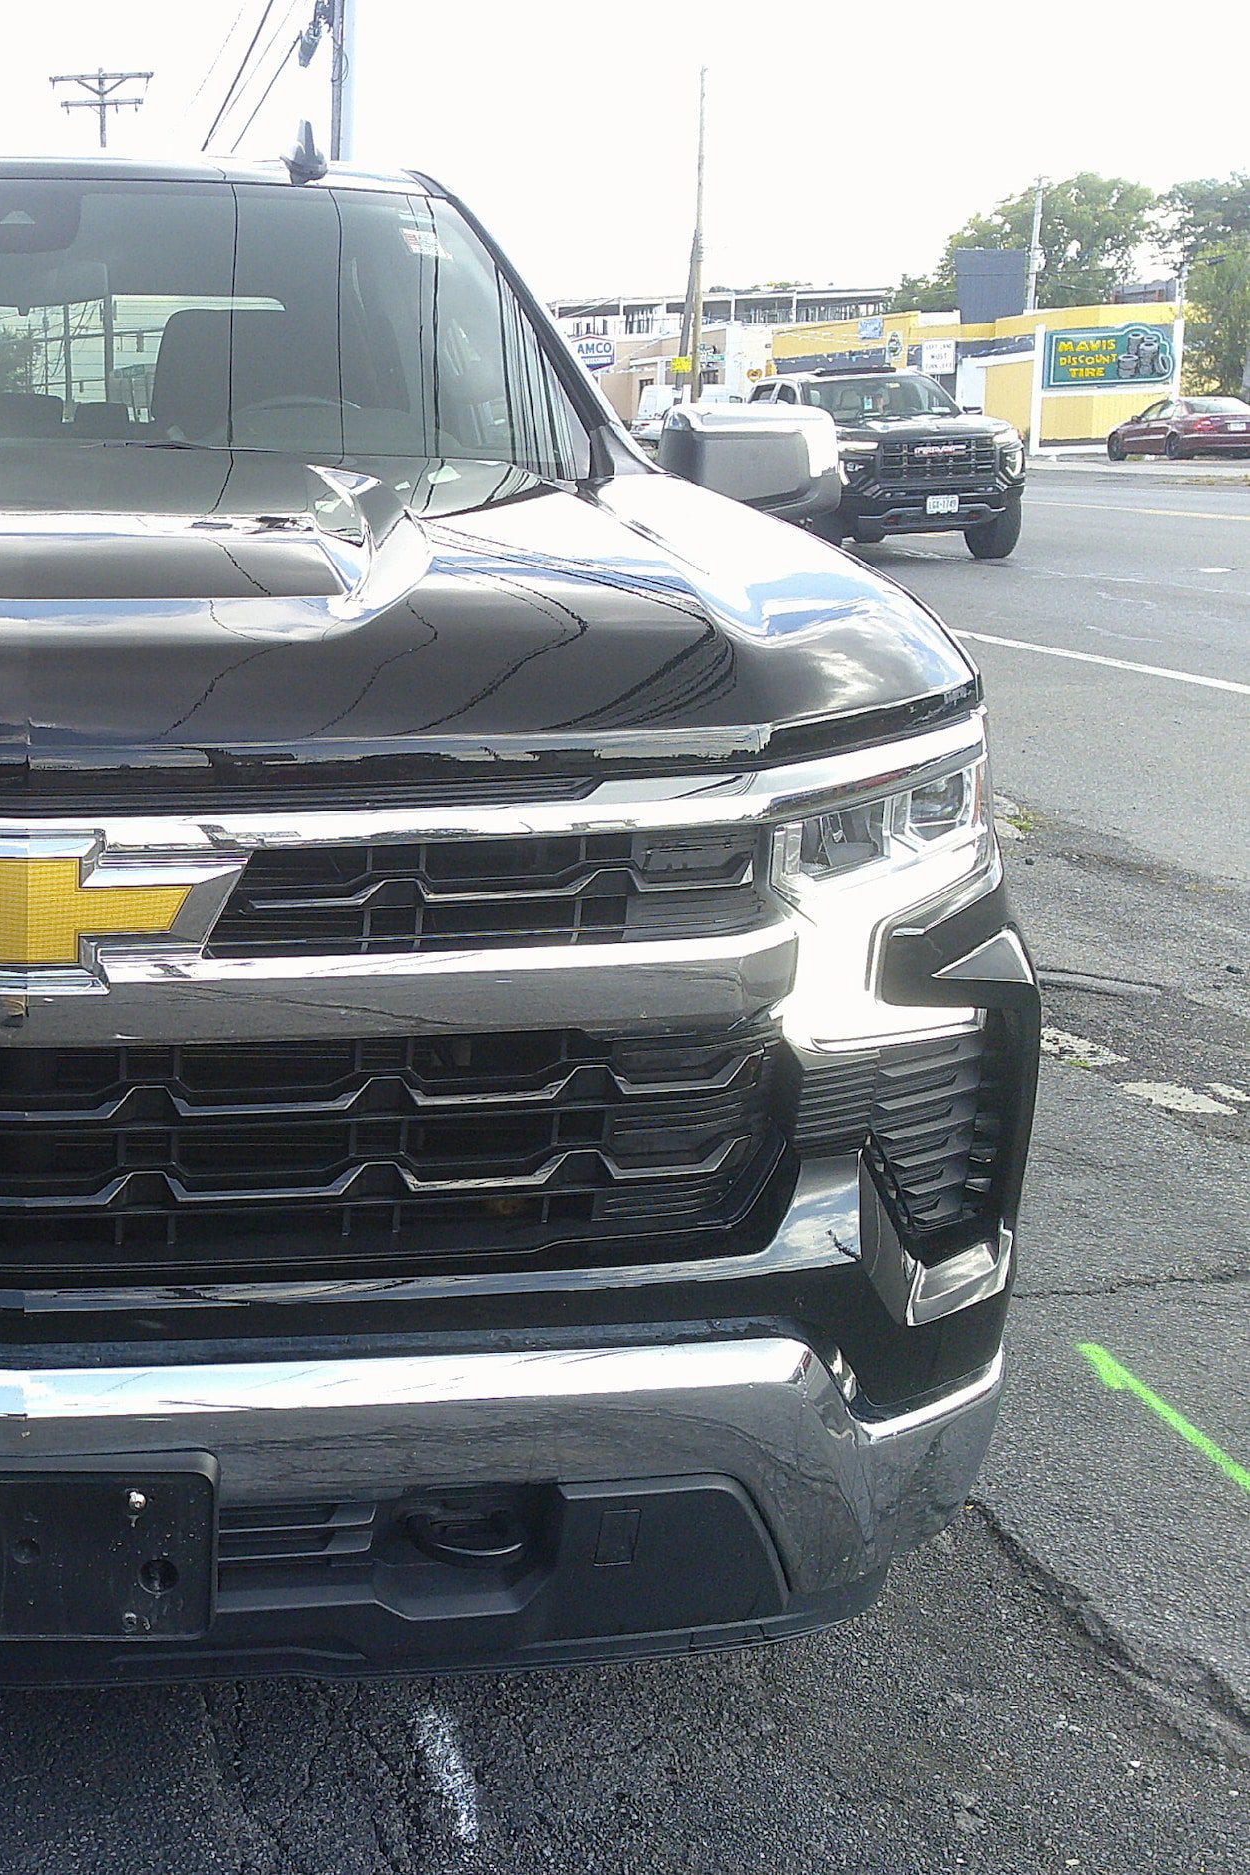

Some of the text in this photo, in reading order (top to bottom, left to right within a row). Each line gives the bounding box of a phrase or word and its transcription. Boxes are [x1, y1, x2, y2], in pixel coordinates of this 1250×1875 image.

[1058, 339, 1116, 351] MAVIS
[930, 352, 947, 360] MUST
[1059, 353, 1118, 366] DISCOUNT
[1069, 367, 1105, 378] TIRE
